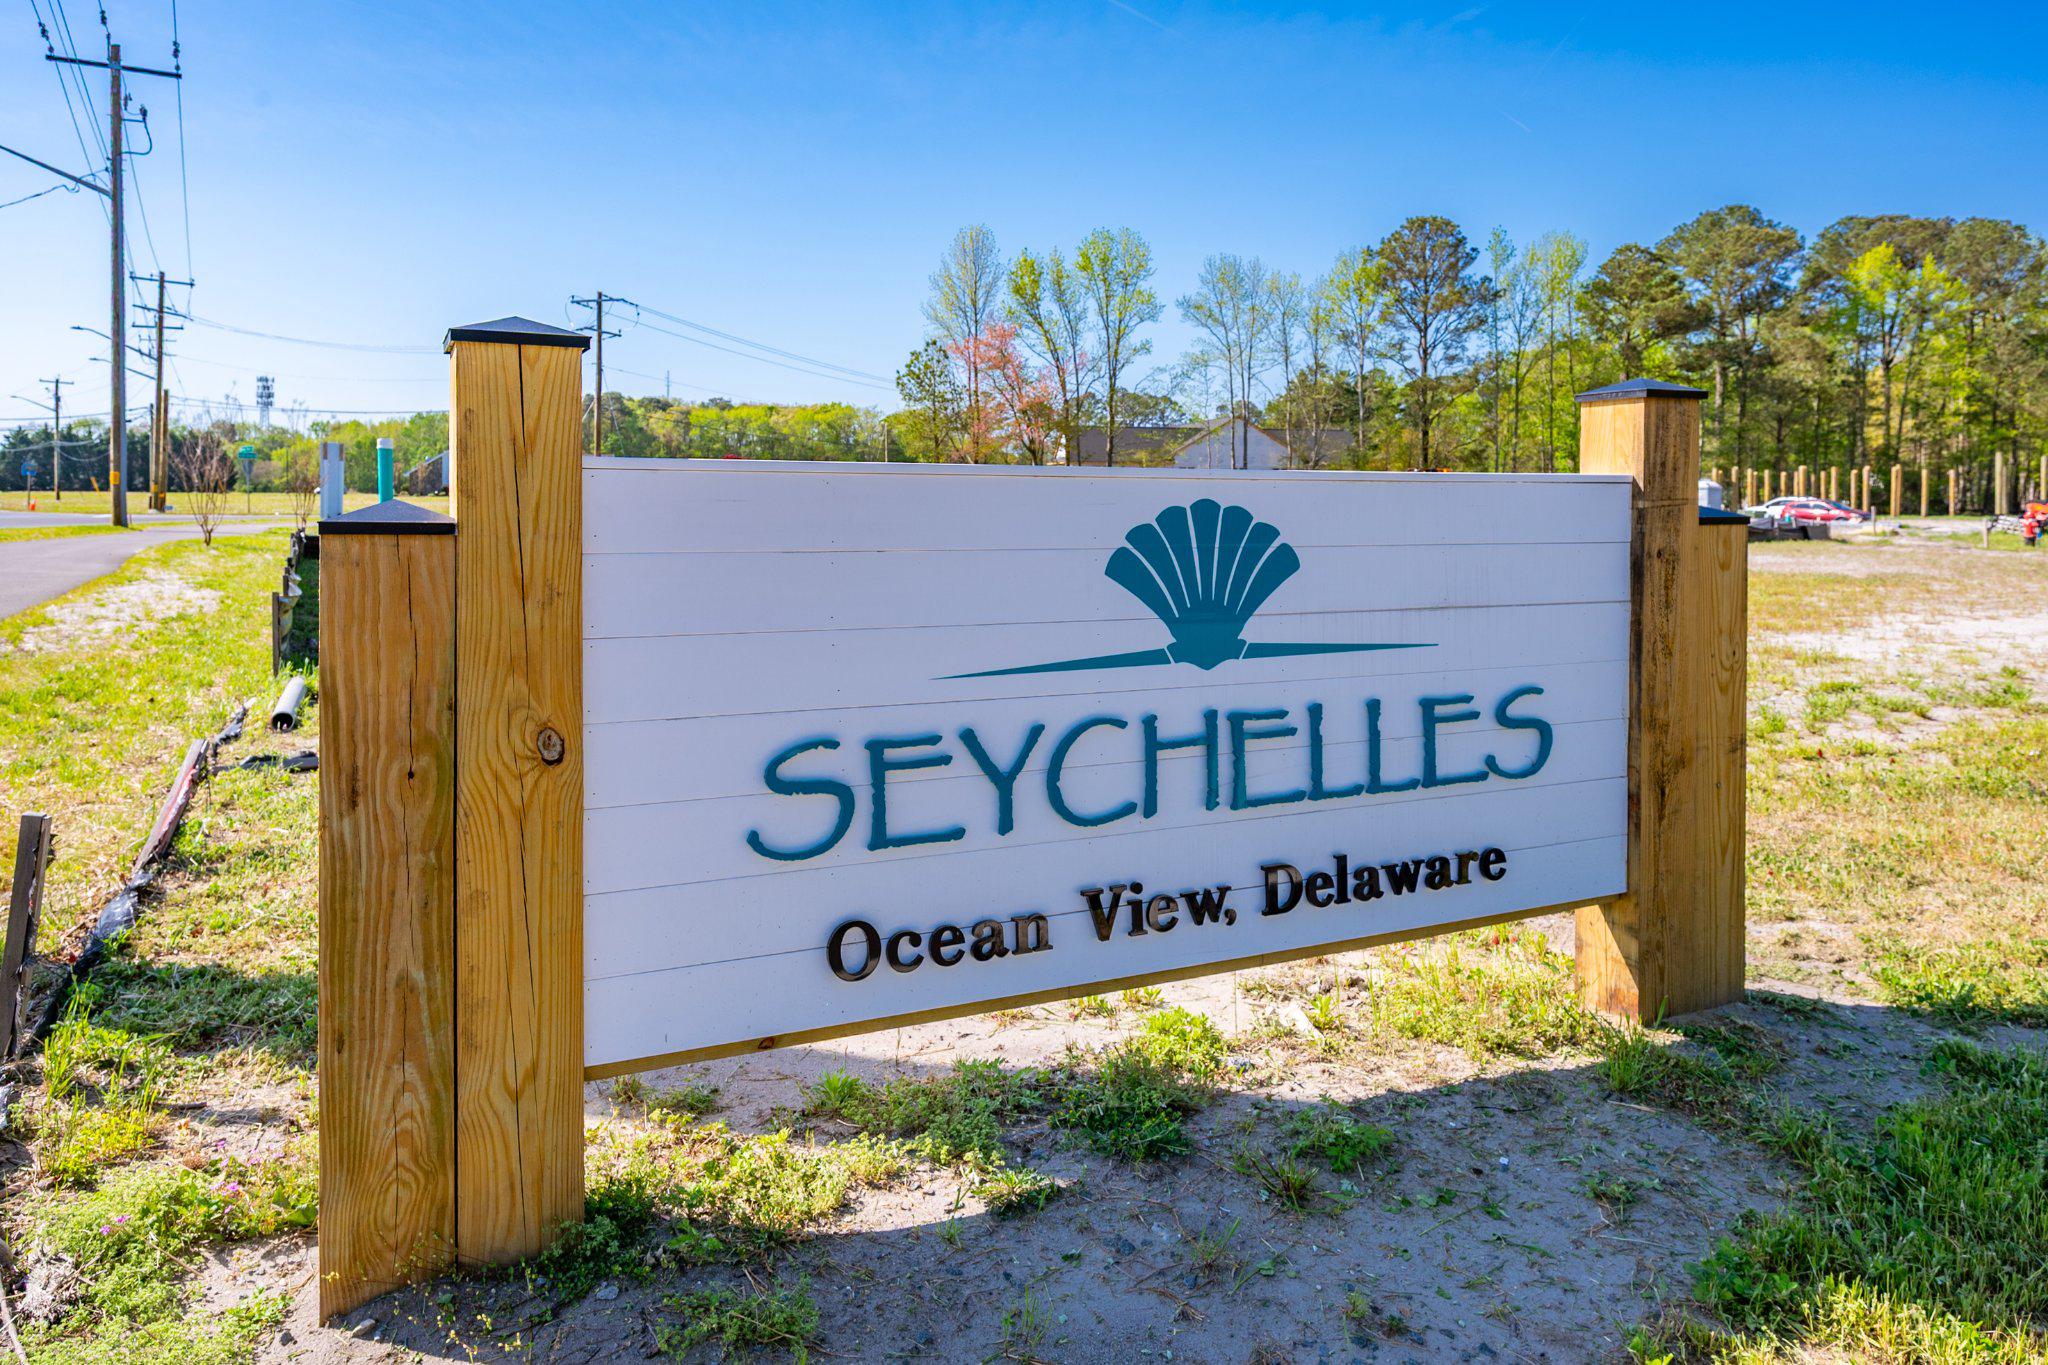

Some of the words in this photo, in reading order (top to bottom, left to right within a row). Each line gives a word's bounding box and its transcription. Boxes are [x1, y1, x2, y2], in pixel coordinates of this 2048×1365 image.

[747, 686, 1554, 861] SEYCHELLES
[827, 912, 1053, 982] Ocean
[1080, 882, 1237, 942] View,
[1260, 847, 1507, 916] Delaware
